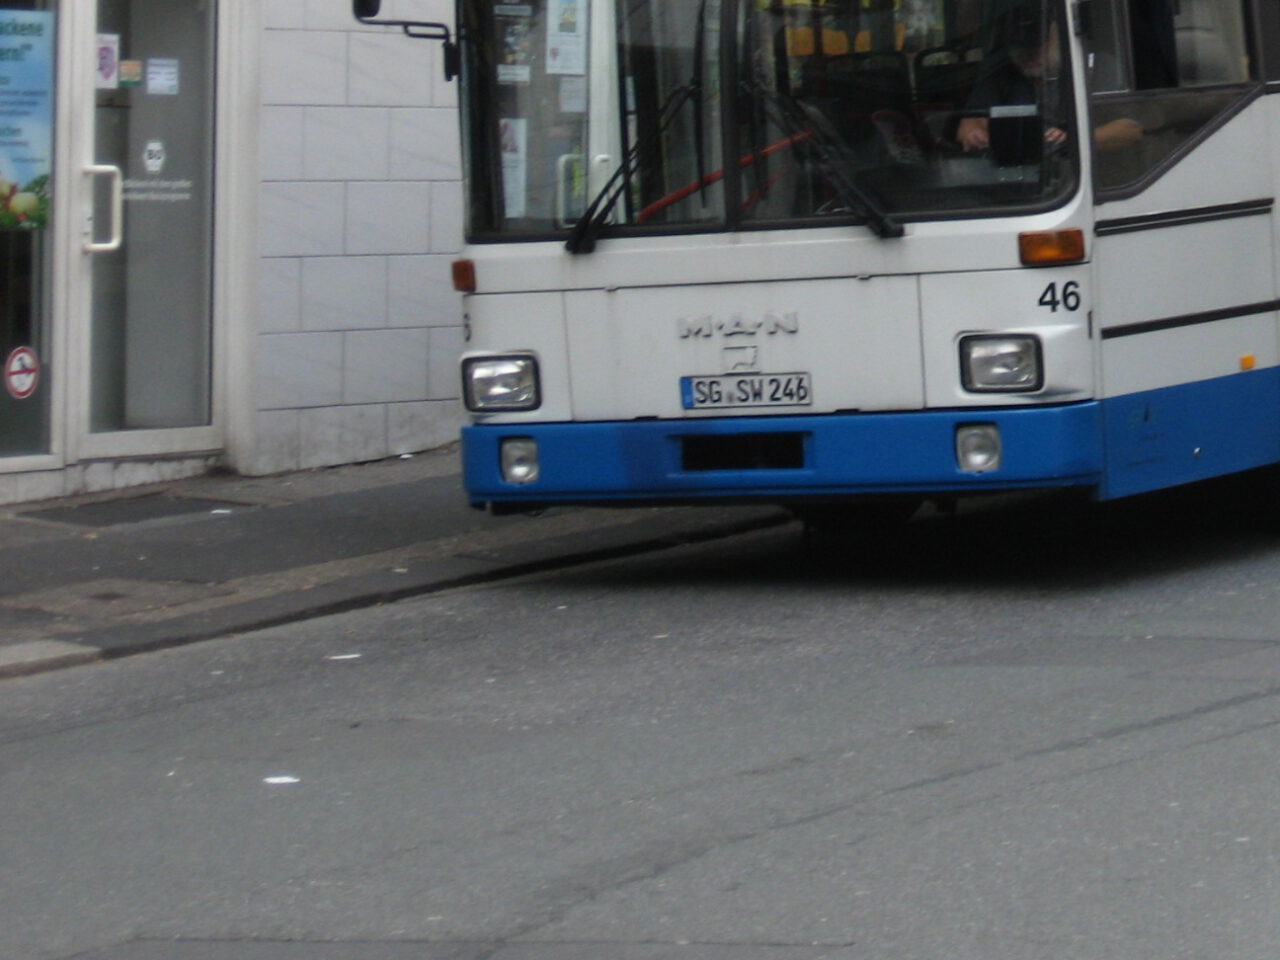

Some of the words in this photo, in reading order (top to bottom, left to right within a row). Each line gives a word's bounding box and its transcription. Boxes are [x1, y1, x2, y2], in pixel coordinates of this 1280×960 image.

[1037, 280, 1081, 313] 46
[694, 380, 722, 404] SG
[736, 379, 764, 402] SW
[768, 377, 808, 402] 246
